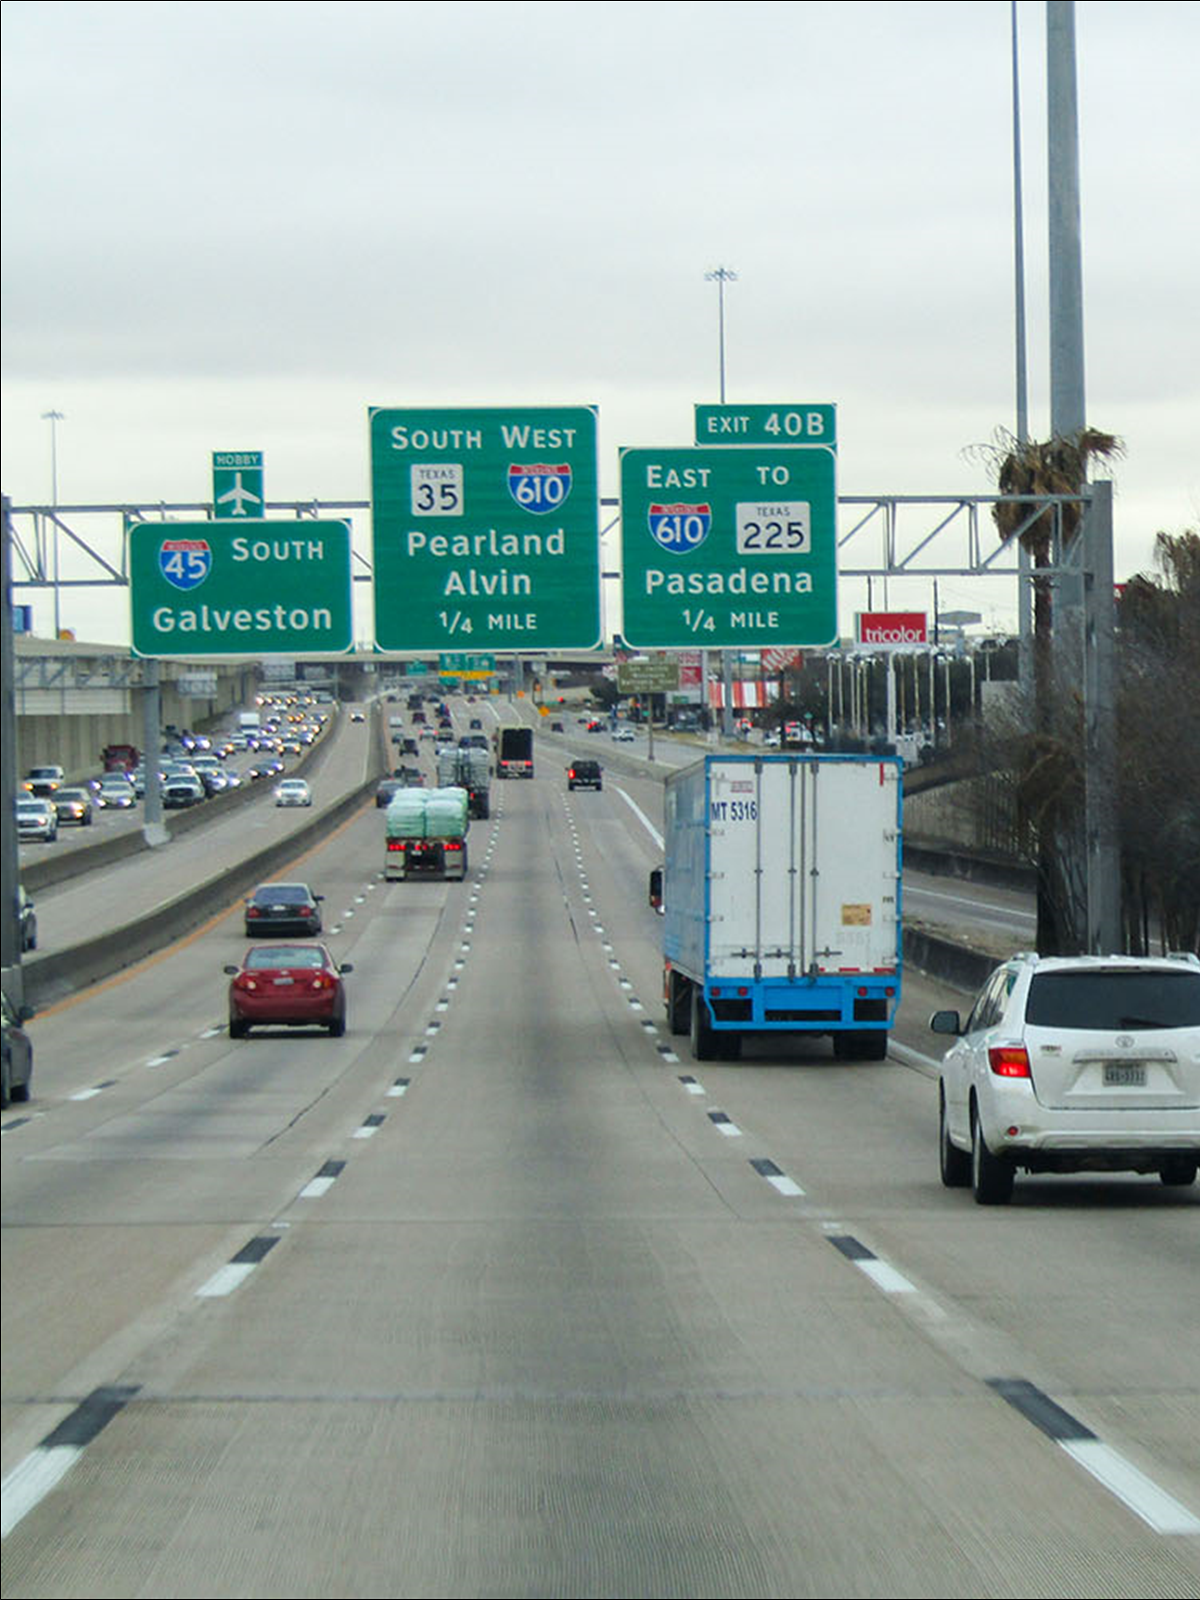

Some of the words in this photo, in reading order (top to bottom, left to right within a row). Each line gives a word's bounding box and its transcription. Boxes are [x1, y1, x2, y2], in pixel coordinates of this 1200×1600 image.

[707, 416, 750, 433] EXIT
[764, 412, 825, 436] 40B
[391, 426, 482, 450] SOUTH
[501, 425, 577, 449] WEST
[216, 453, 259, 466] HOBBY
[419, 468, 456, 480] TEXAS
[646, 464, 712, 488] EAST
[756, 465, 790, 485] TO
[417, 483, 458, 511] 35
[516, 477, 564, 505] 610
[756, 506, 791, 518] TEXAS
[408, 528, 565, 557] Pearland
[655, 516, 705, 544] 610
[743, 521, 805, 549] 225
[232, 537, 324, 562] SOUTH
[164, 551, 208, 580] 45
[444, 568, 531, 596] Alvin
[646, 567, 813, 595] Pasadena
[153, 604, 332, 633] Galveston
[439, 611, 473, 634] 1/4
[488, 613, 537, 630] MILE
[682, 609, 716, 632] 1/4
[730, 611, 779, 628] MILE
[864, 624, 924, 643] tricolor
[711, 801, 728, 821] MT
[731, 801, 757, 821] 5316
